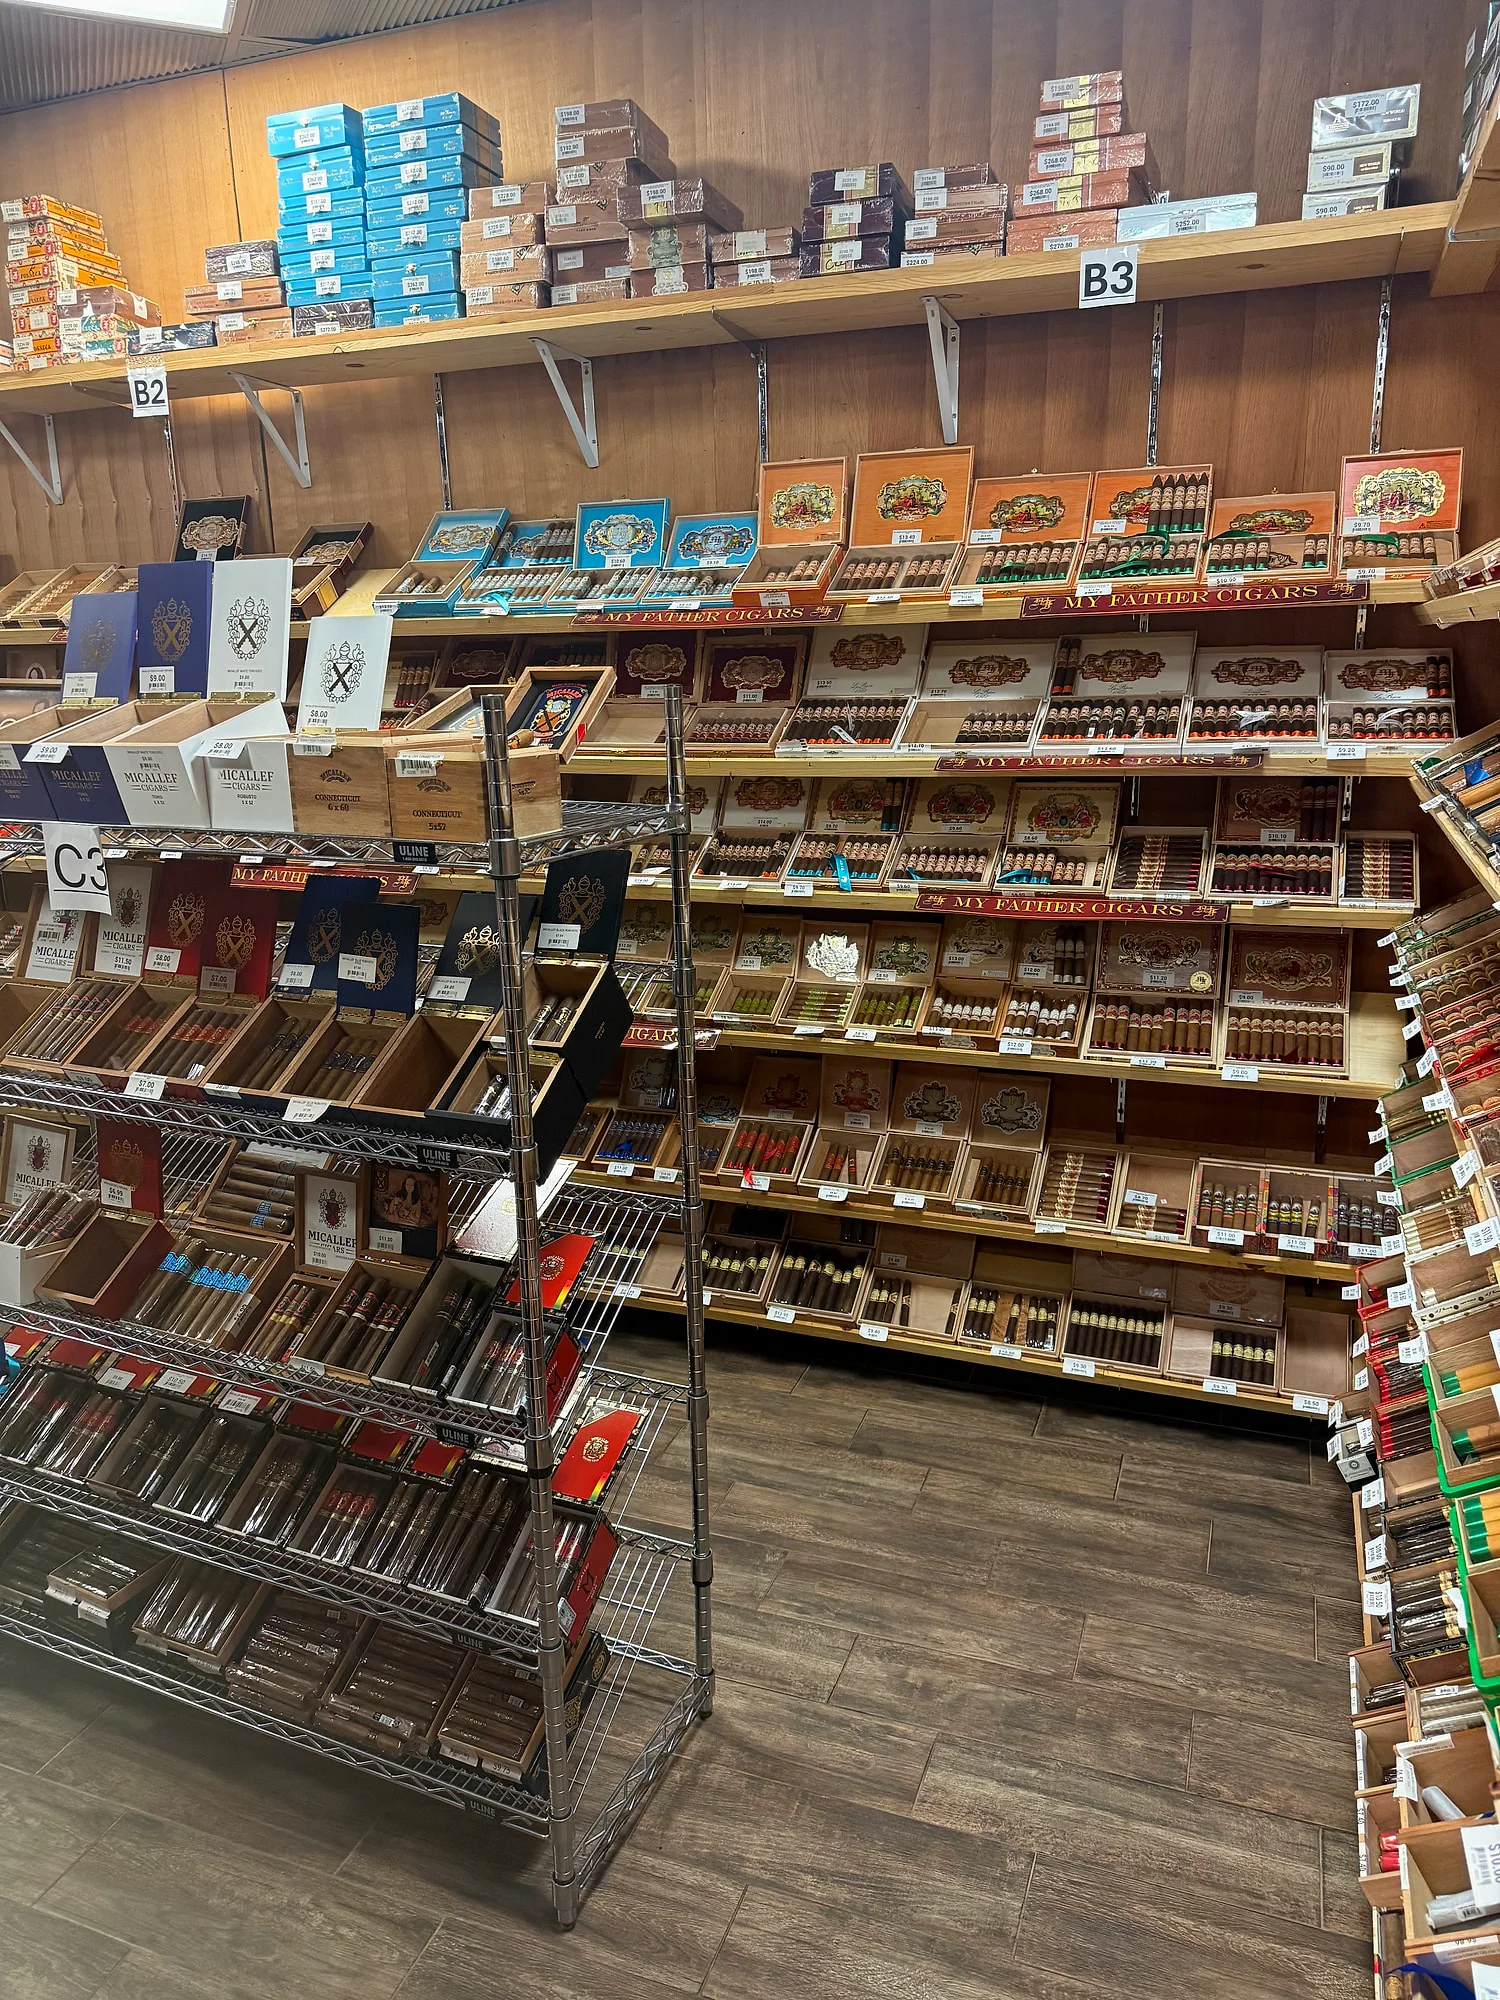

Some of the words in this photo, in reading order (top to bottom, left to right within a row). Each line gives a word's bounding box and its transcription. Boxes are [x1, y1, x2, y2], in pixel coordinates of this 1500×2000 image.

[1353, 98, 1380, 109] $172.00
[1044, 156, 1067, 165] $268.00
[1324, 163, 1346, 173] $90.00
[1029, 187, 1053, 197] $268.00
[1315, 205, 1338, 215] $90.00
[1175, 219, 1200, 228] $252.00
[906, 259, 928, 267] $224.00
[1084, 260, 1134, 298] B3
[133, 378, 165, 406] B2
[1353, 521, 1371, 529] $9.70
[1357, 567, 1376, 576] $9.70
[1062, 596, 1099, 609] MY
[1108, 591, 1212, 606] FATHER
[1216, 585, 1319, 600] CIGARS
[604, 612, 640, 623] MY
[641, 611, 721, 622] FATHER
[725, 607, 805, 621] CIGARS
[149, 674, 166, 682] $9.00
[310, 708, 328, 718] $8.00
[40, 746, 58, 755] $9.00
[213, 741, 234, 750] $8.00
[976, 758, 1016, 768] MY
[1018, 757, 1111, 767] FATHER
[1118, 756, 1216, 766] CIGARS
[51, 769, 101, 782] MICALLEF
[124, 772, 178, 784] MICALLEF
[218, 769, 274, 782] MICALLEF
[67, 781, 93, 789] CIGARS
[141, 784, 168, 792] CIGARS
[232, 783, 260, 792] CIGARS
[315, 793, 361, 802] CONNECTICUT
[412, 809, 462, 818] CONNECTICUT
[399, 844, 429, 857] ULINE
[54, 843, 108, 891] C3
[232, 867, 260, 881] MY
[261, 870, 308, 885] FATH
[953, 896, 991, 908] MY
[994, 898, 1088, 913] FATHER
[1091, 901, 1185, 917] CIGARS
[112, 942, 136, 951] CIGARS
[44, 958, 67, 967] CIGARS
[114, 955, 133, 966] $11.50
[155, 954, 171, 963] $8.00
[211, 974, 228, 984] $7.00
[628, 1027, 679, 1043] IGAR
[138, 1079, 155, 1089] $7.00
[422, 1148, 451, 1162] ULINE
[308, 1229, 357, 1249] MICALLEF
[1216, 1231, 1236, 1239] $11.00
[1287, 1239, 1307, 1248] $11.00
[442, 1426, 470, 1443] ULINE
[456, 1633, 484, 1650] ULINE
[469, 1800, 497, 1817] ULINE
